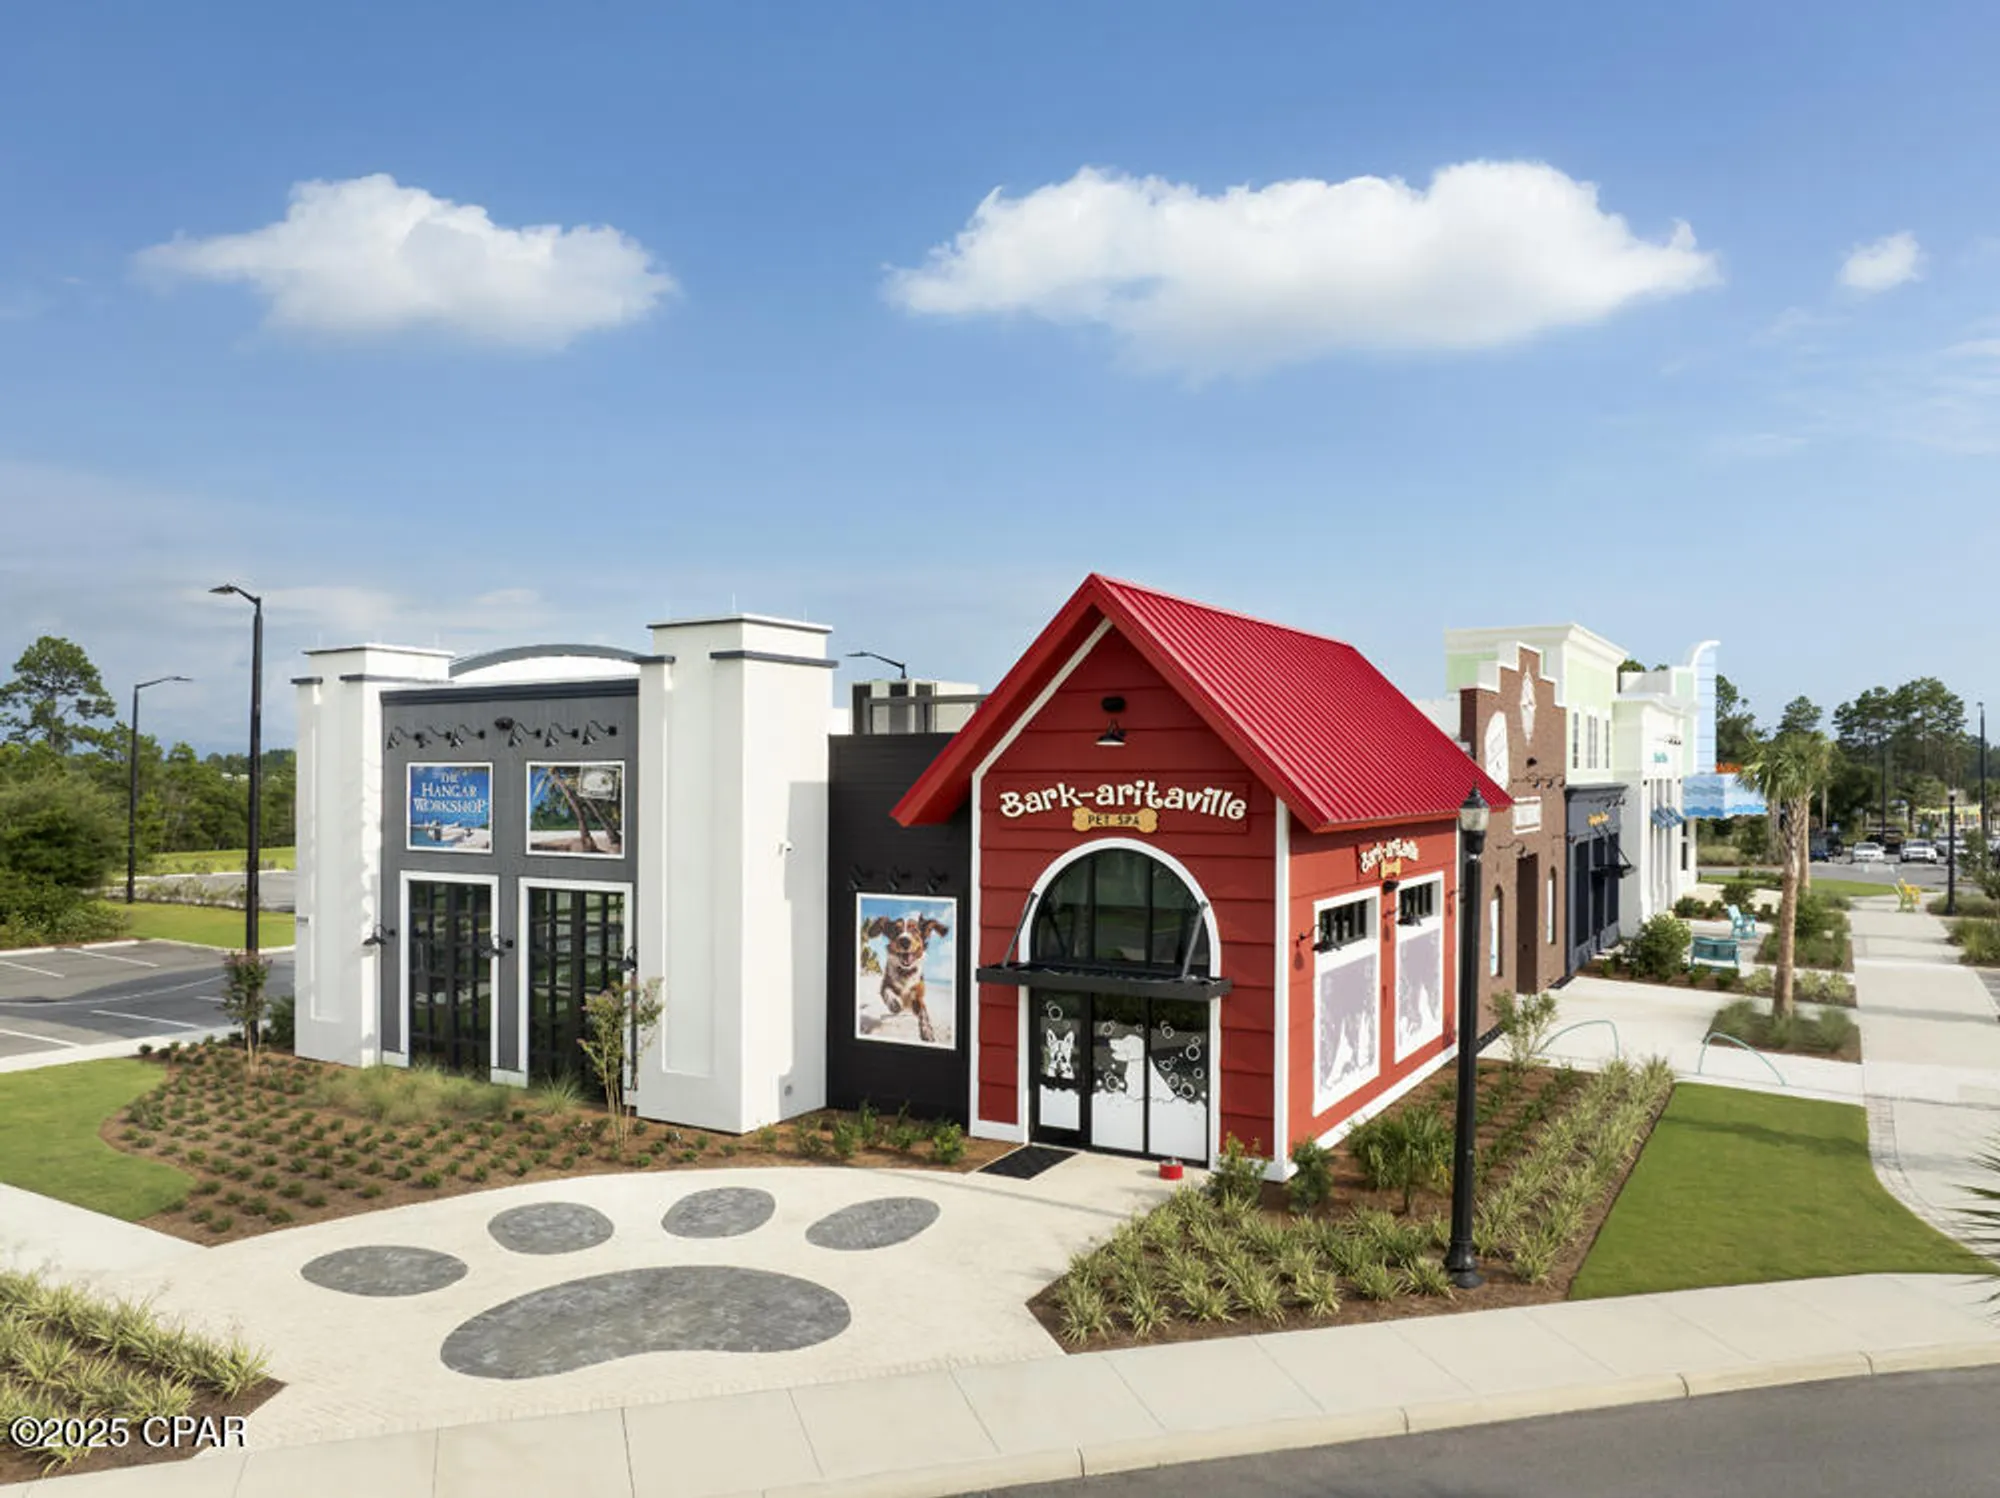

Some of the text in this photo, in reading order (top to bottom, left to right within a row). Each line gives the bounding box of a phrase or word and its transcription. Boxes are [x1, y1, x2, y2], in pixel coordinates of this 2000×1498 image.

[421, 782, 477, 797] HANGAR
[413, 798, 486, 813] WORKSHOP
[1000, 780, 1247, 820] Bark-aritaville
[1088, 815, 1110, 825] PET
